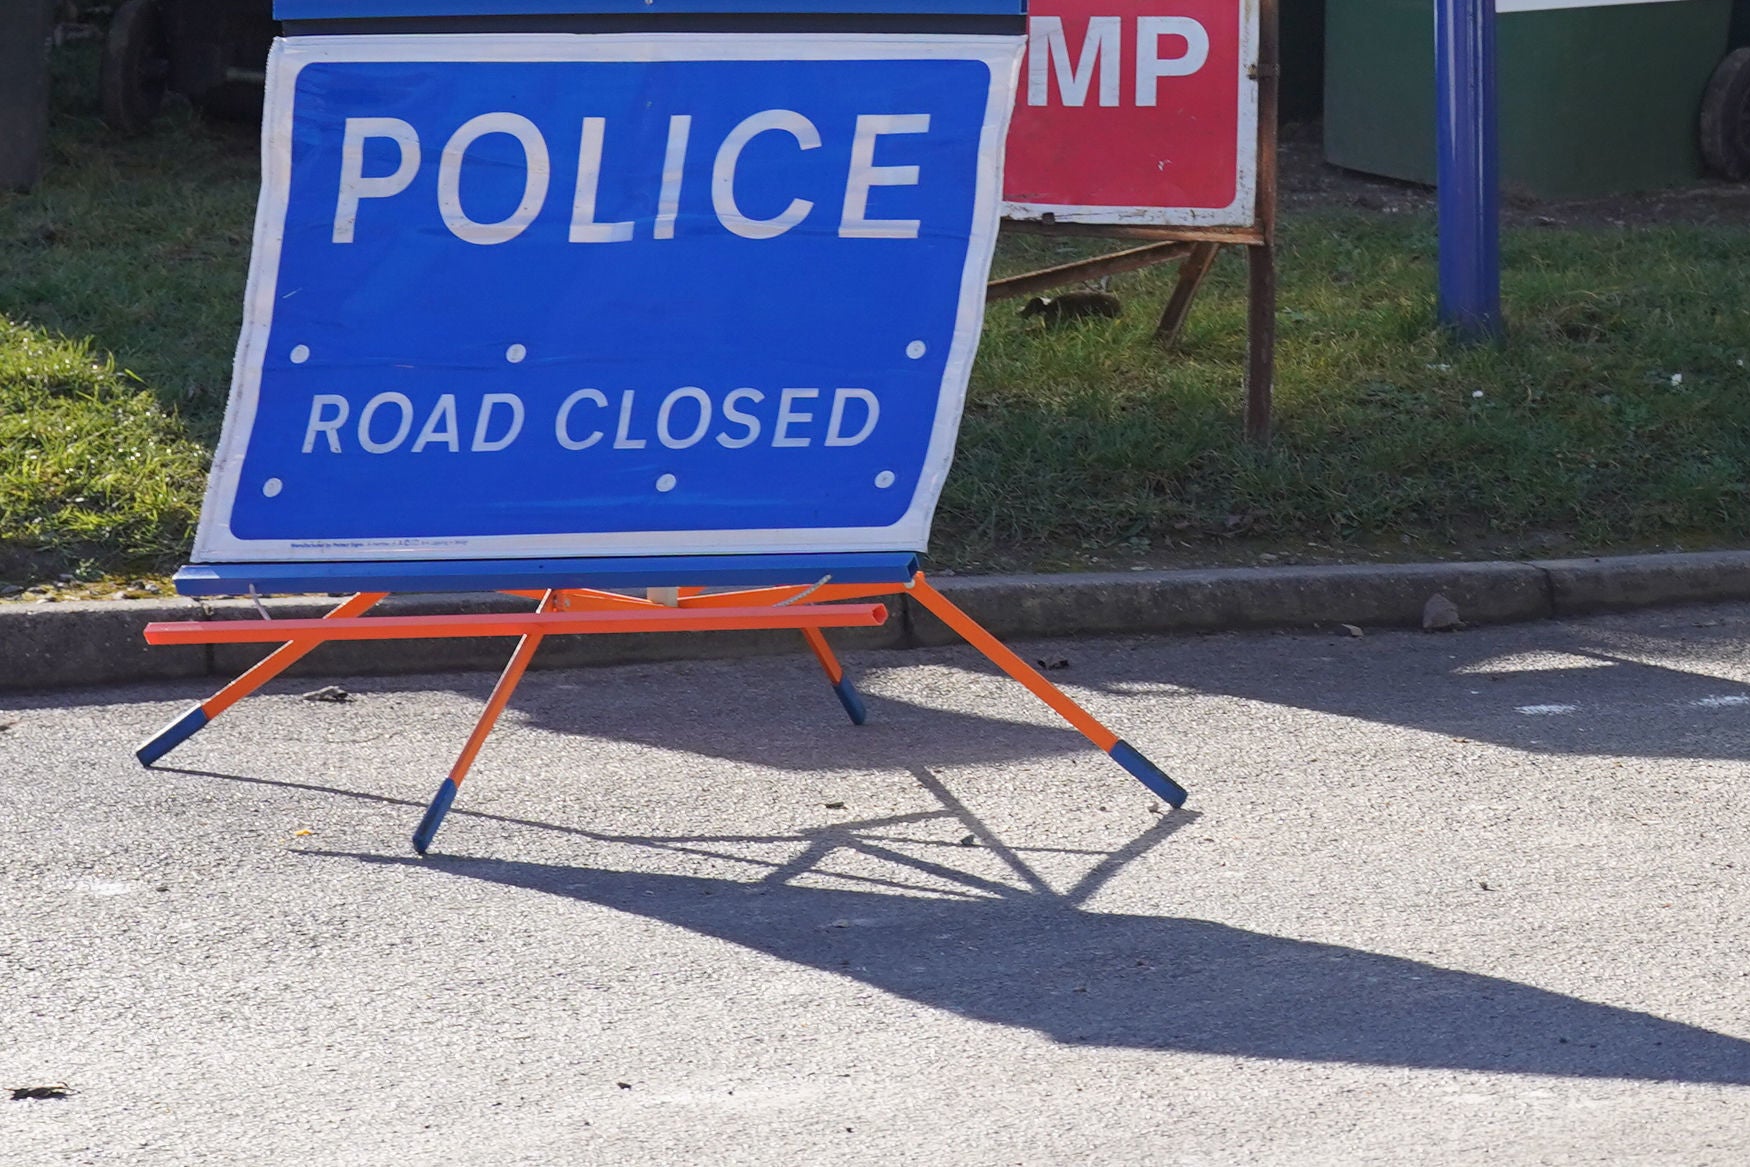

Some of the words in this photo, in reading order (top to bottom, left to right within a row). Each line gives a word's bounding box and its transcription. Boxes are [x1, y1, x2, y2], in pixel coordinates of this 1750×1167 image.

[1026, 15, 1210, 108] MP
[331, 107, 931, 246] POLICE
[301, 390, 526, 454] ROAD
[555, 385, 881, 450] CLOSED
